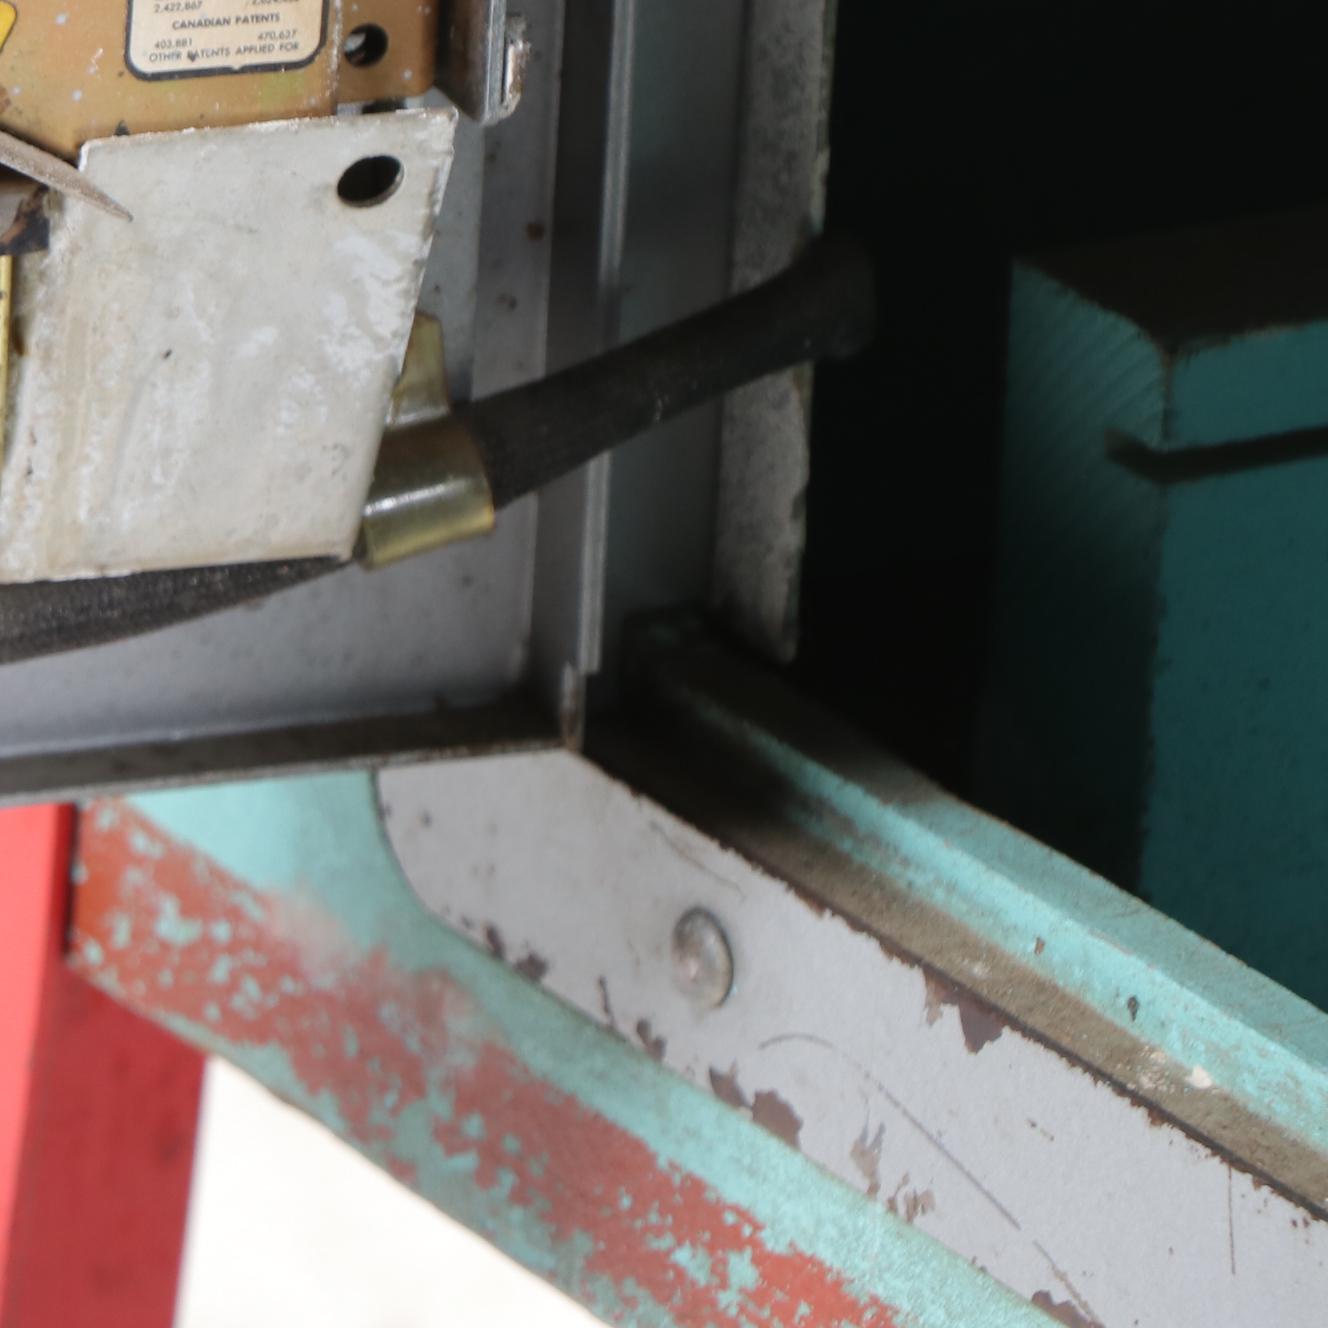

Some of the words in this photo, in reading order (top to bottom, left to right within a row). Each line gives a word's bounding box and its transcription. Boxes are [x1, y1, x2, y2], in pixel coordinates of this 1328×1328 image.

[172, 17, 231, 30] CANADIAN
[236, 13, 280, 23] PATENTS
[149, 52, 182, 62] OTHER
[187, 47, 230, 60] PATENTS
[236, 44, 275, 55] APPLIED
[280, 43, 299, 51] FOR
